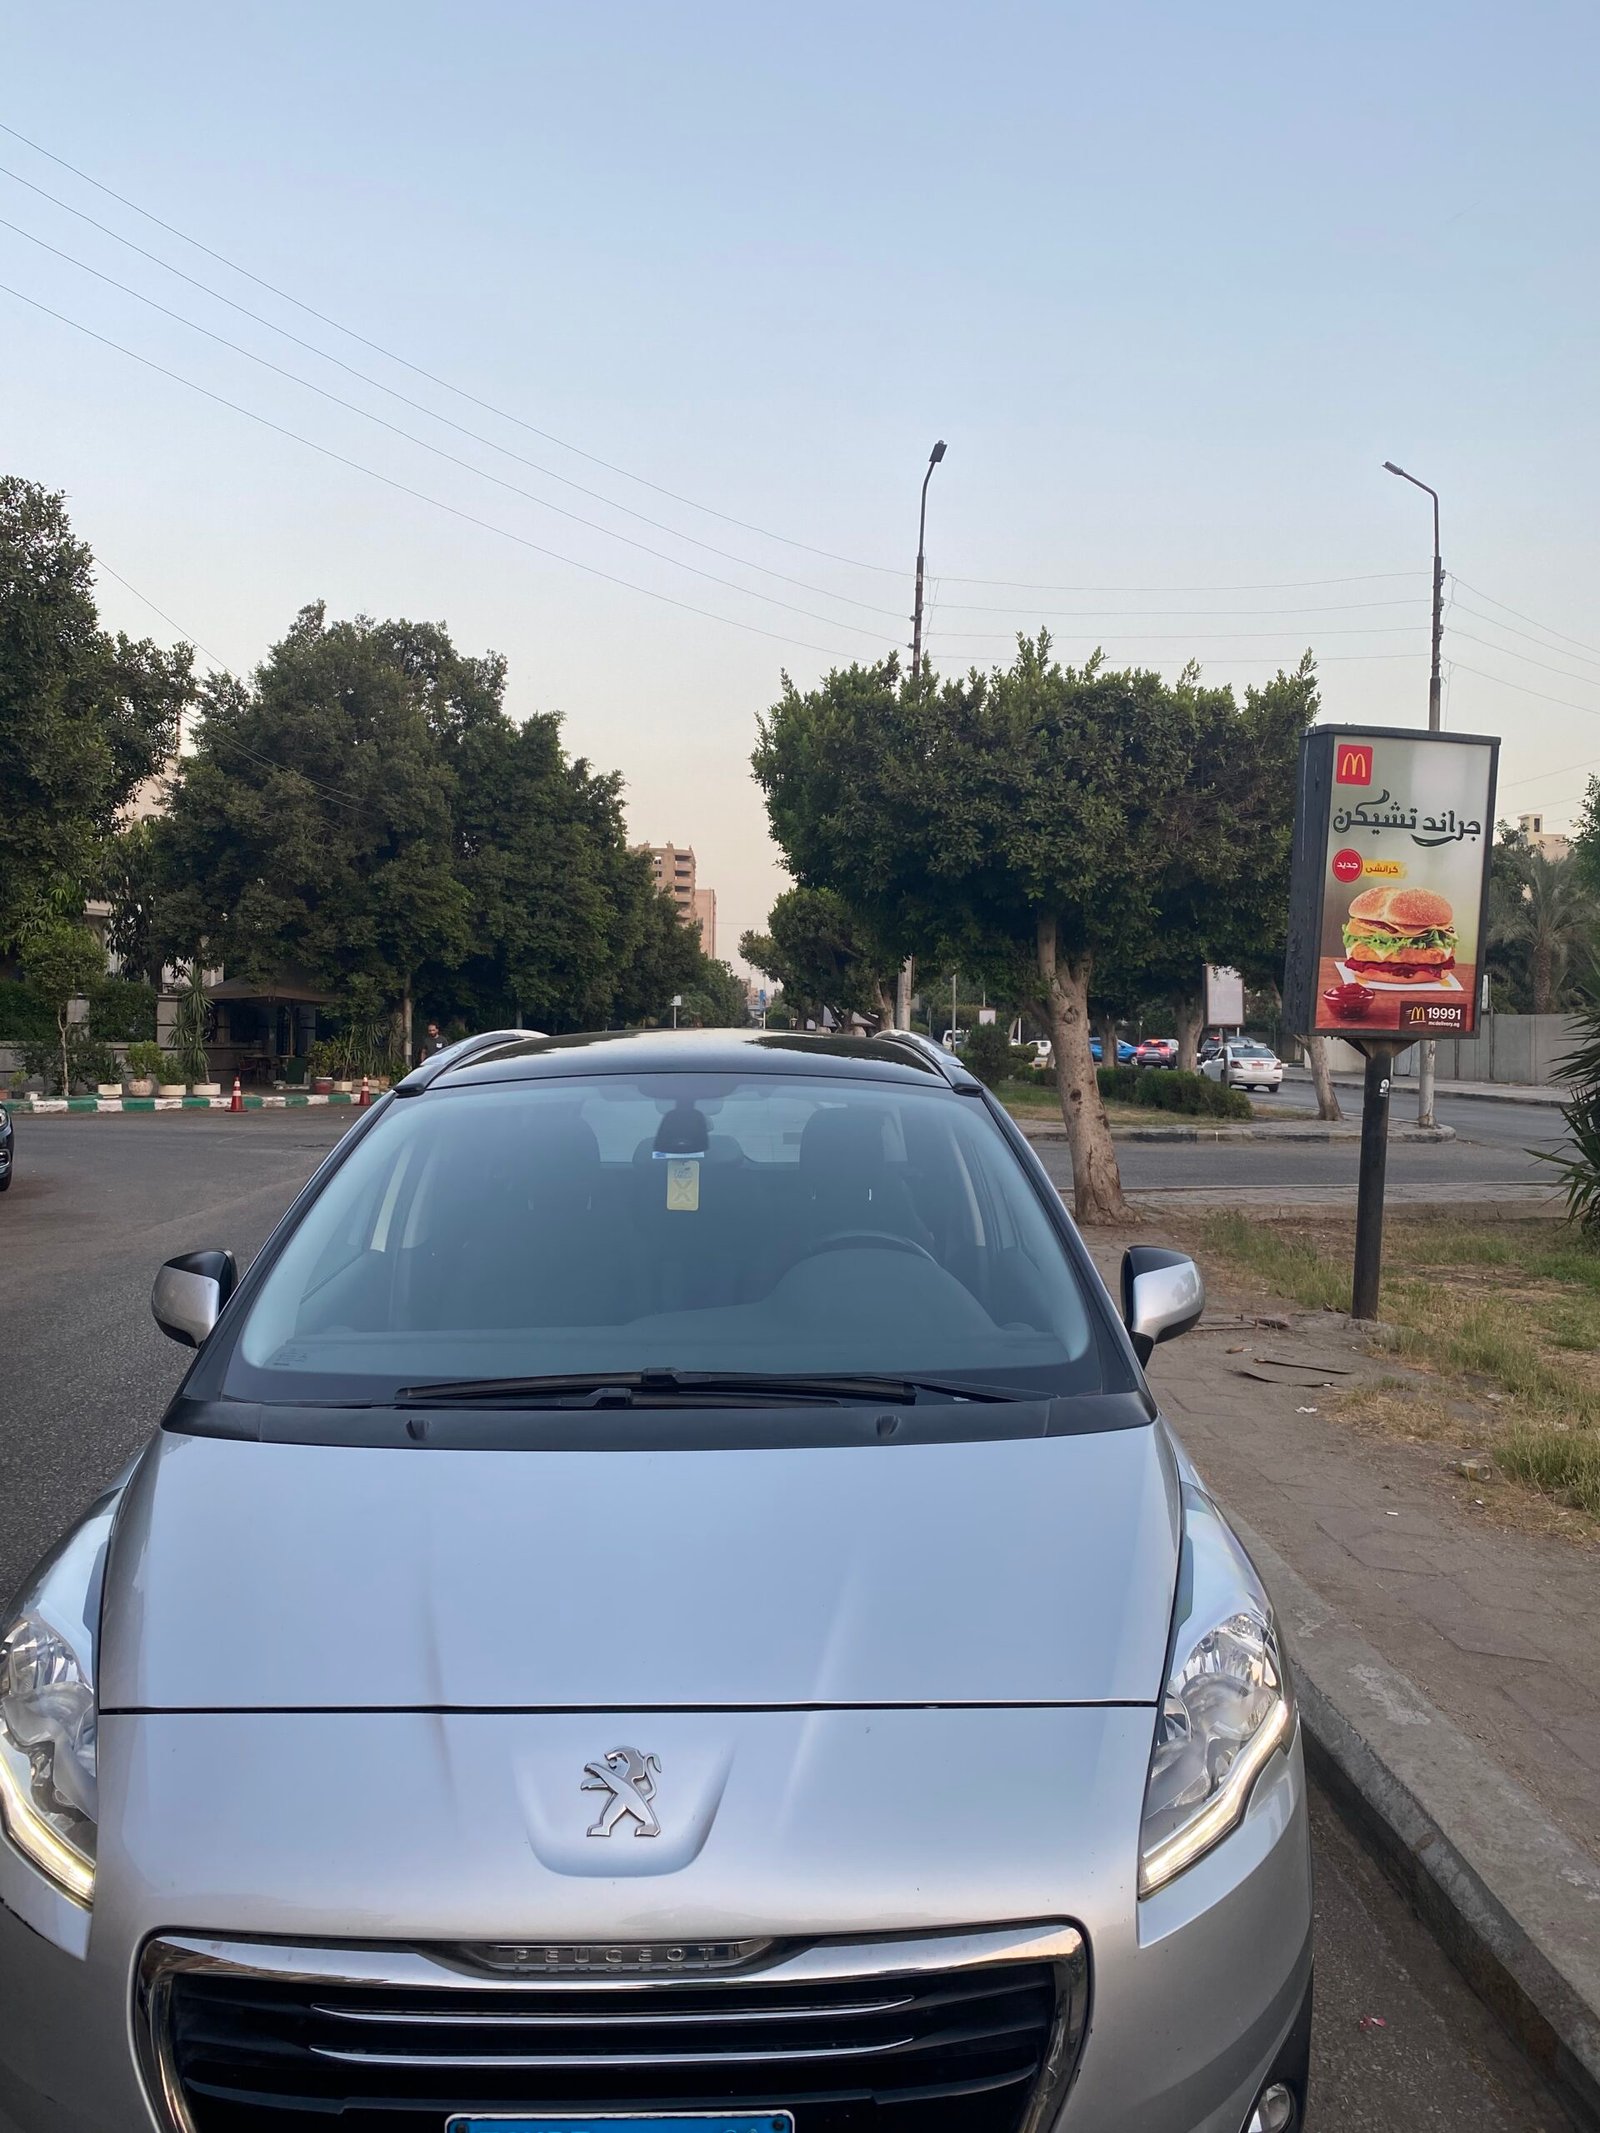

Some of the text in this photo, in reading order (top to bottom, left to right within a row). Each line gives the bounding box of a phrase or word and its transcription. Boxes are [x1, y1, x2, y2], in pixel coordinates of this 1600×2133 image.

[1333, 789, 1481, 847] جراند تشيكن
[1337, 861, 1359, 870] جديد
[1427, 1007, 1461, 1020] 19991
[514, 1947, 715, 1963] PEUGEOT
